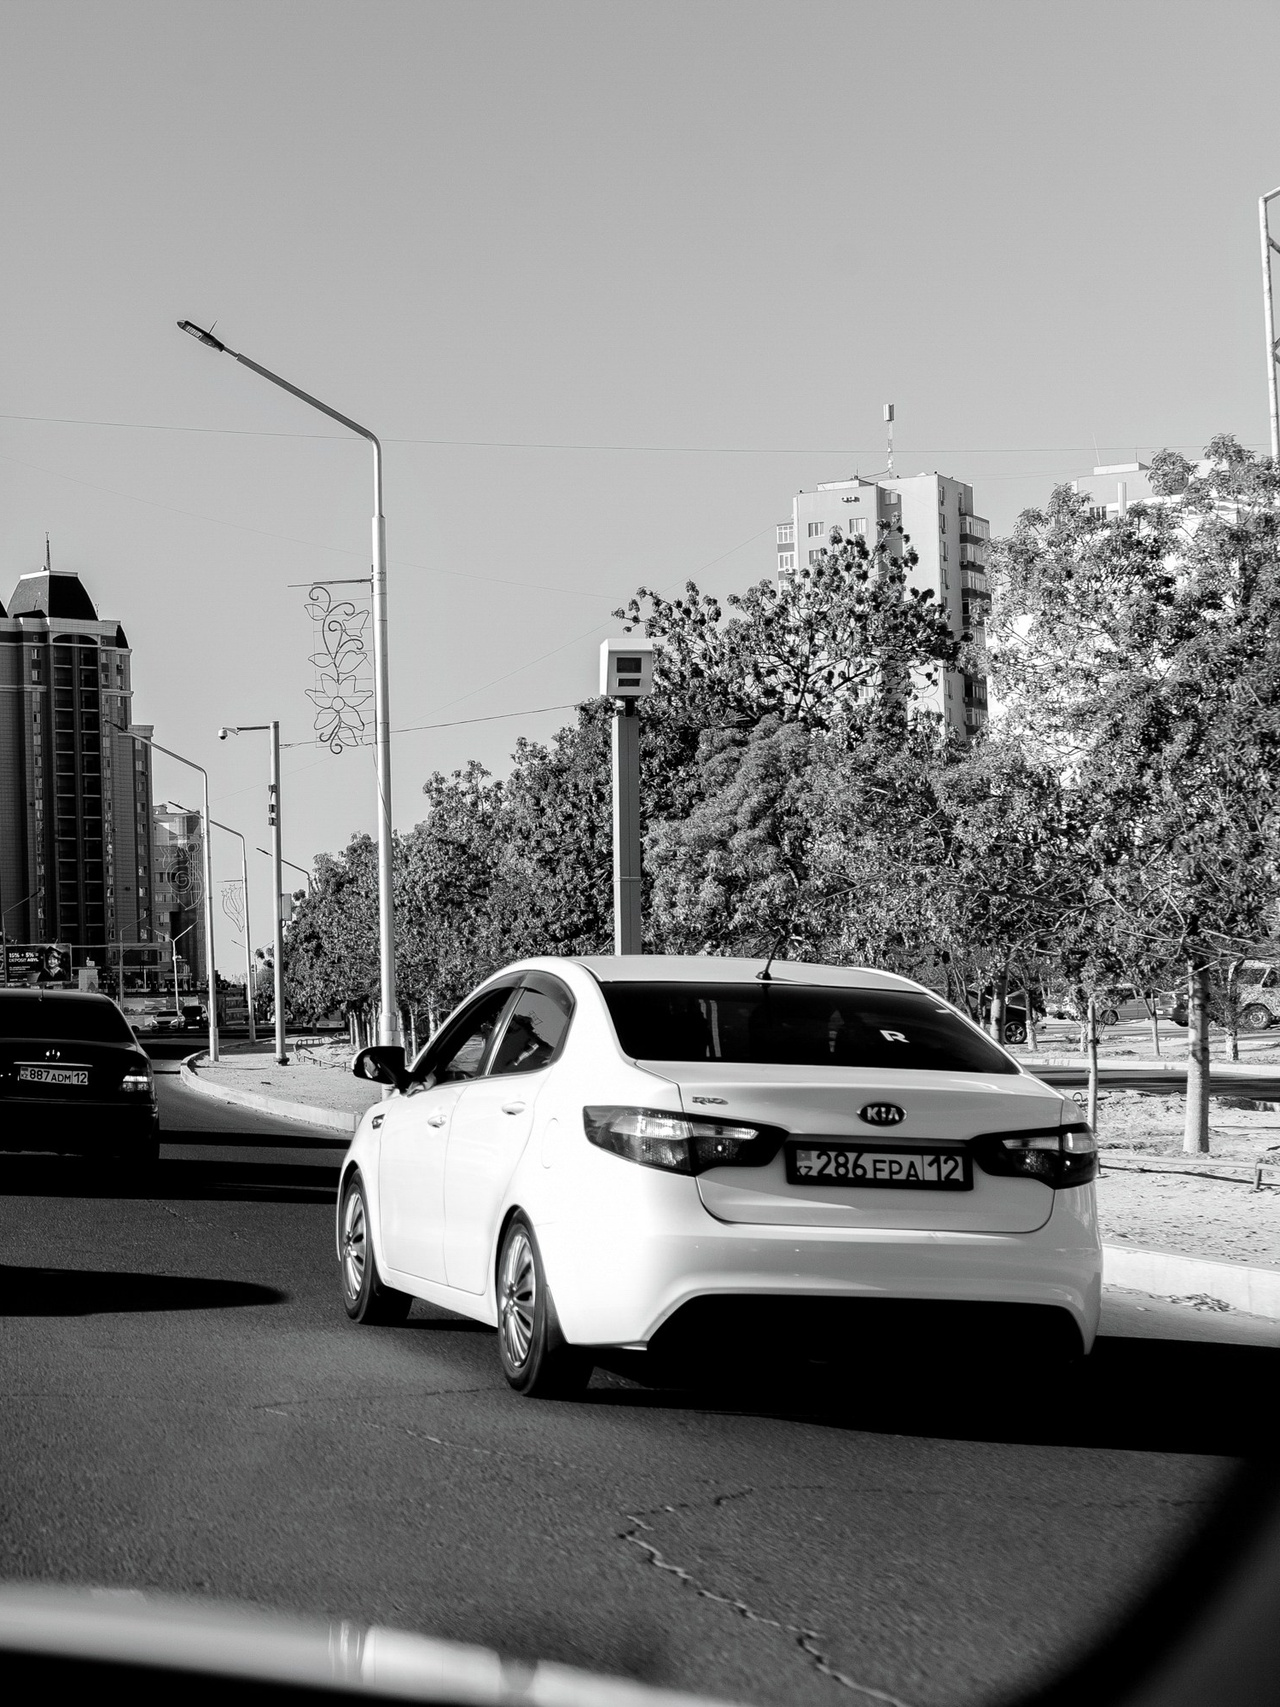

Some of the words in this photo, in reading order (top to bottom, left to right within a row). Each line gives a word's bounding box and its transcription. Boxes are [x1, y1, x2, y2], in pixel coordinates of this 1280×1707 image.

[29, 1068, 50, 1081] 887
[51, 1073, 71, 1083] ADM
[73, 1072, 87, 1084] 12
[866, 1106, 899, 1122] KIA
[816, 1151, 867, 1178] 286
[873, 1158, 921, 1181] FPA
[927, 1155, 960, 1182] 12
